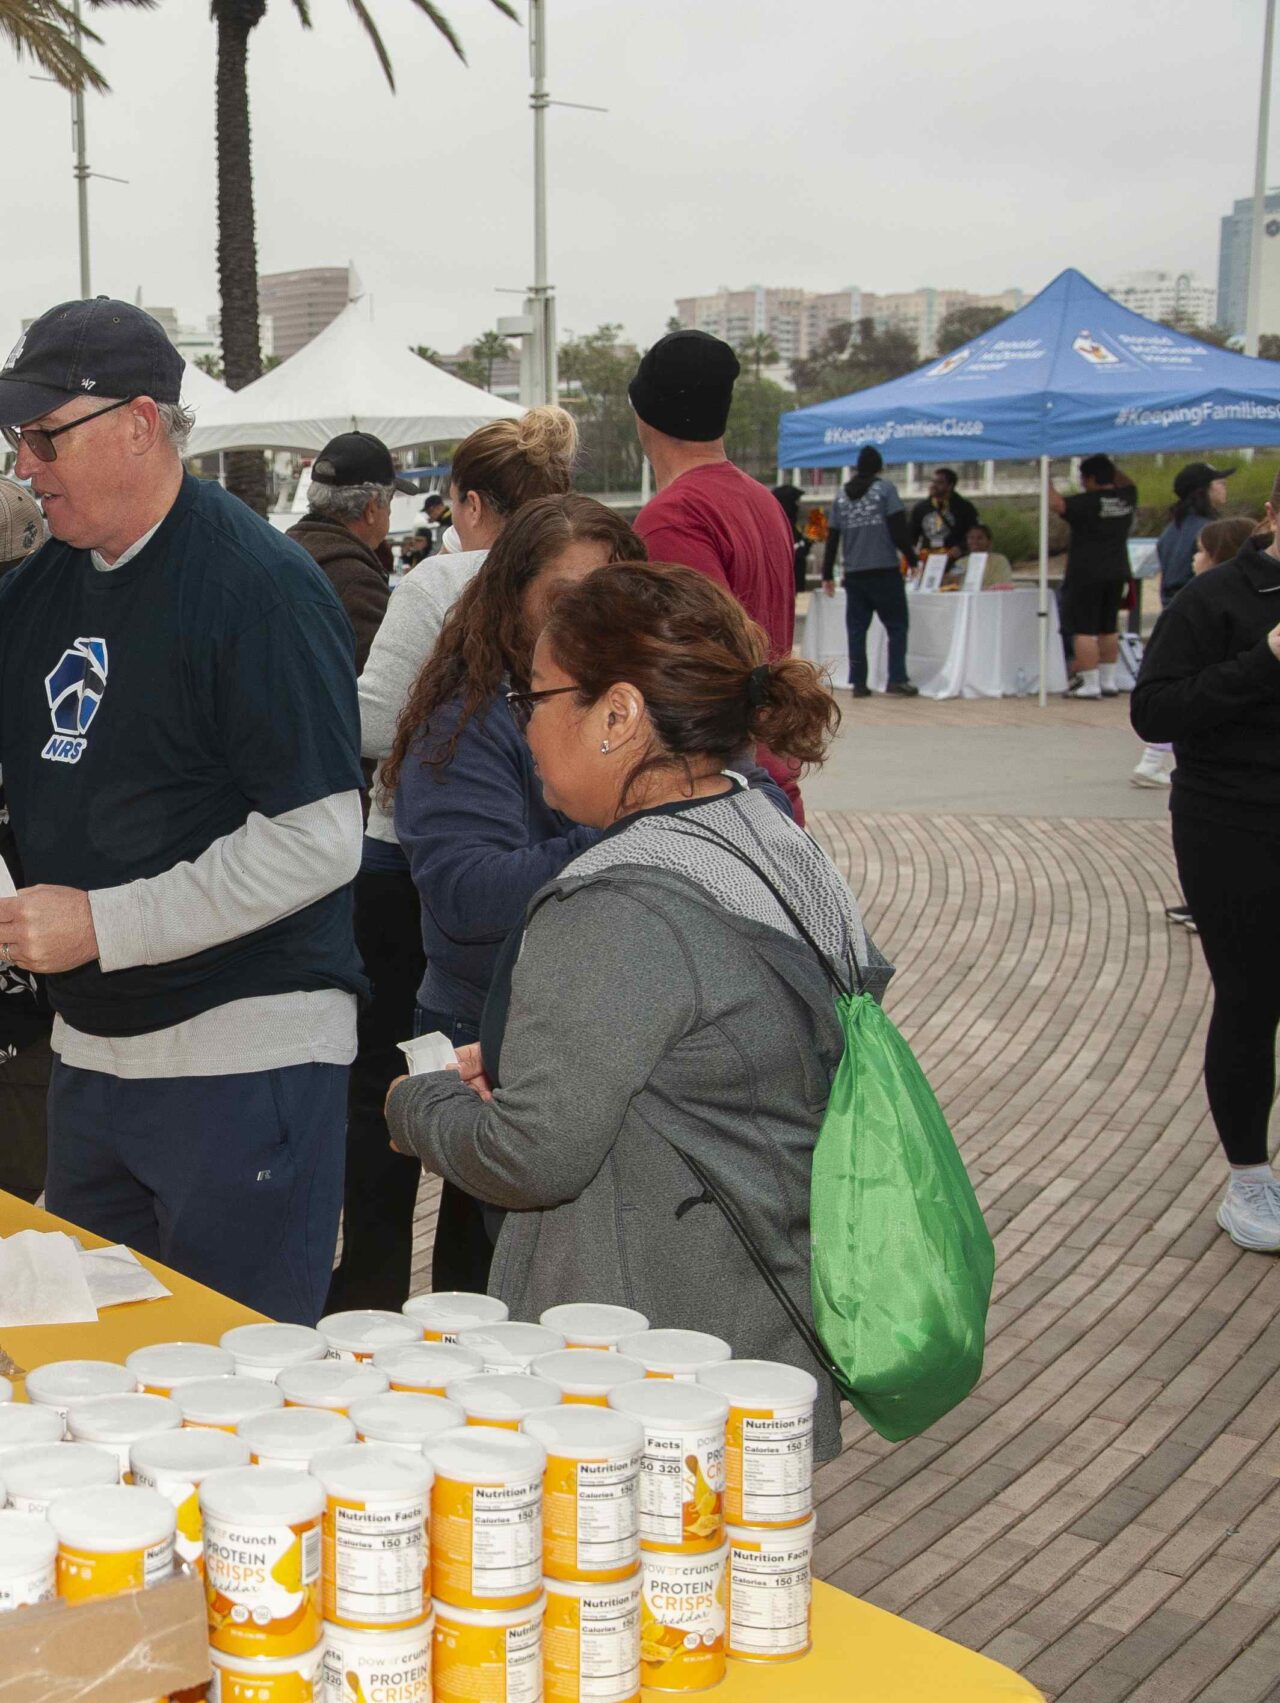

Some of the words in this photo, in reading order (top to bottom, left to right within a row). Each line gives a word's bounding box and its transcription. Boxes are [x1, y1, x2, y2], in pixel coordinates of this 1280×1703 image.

[1115, 400, 1280, 428] #KeepingFamilies
[824, 418, 984, 446] #KeepingFamiliesClose
[42, 735, 86, 763] NRS
[745, 1420, 795, 1429] Nutrition
[647, 1439, 681, 1449] Facts
[786, 1442, 802, 1452] 150
[580, 1462, 628, 1474] Nutrition
[640, 1461, 654, 1471] 50
[658, 1465, 681, 1474] 320
[476, 1488, 526, 1498] Nutrition
[579, 1491, 614, 1499] Calories
[338, 1509, 391, 1522] Nutrition
[395, 1507, 422, 1519] Facts
[229, 1533, 277, 1545] crunch
[337, 1537, 373, 1548] Calories
[381, 1539, 401, 1549] 150
[206, 1538, 266, 1566] PROTEIN
[733, 1550, 784, 1562] Nutrition
[207, 1553, 267, 1584] CRISPS
[682, 1562, 720, 1576] crunch
[211, 1577, 257, 1592] heddar
[732, 1575, 767, 1586] Calories
[776, 1577, 792, 1586] 150
[650, 1580, 713, 1595] PROTEIN
[583, 1596, 630, 1608] Nutrition
[651, 1593, 713, 1611] CRISPS
[370, 1661, 427, 1685] PROTEIN
